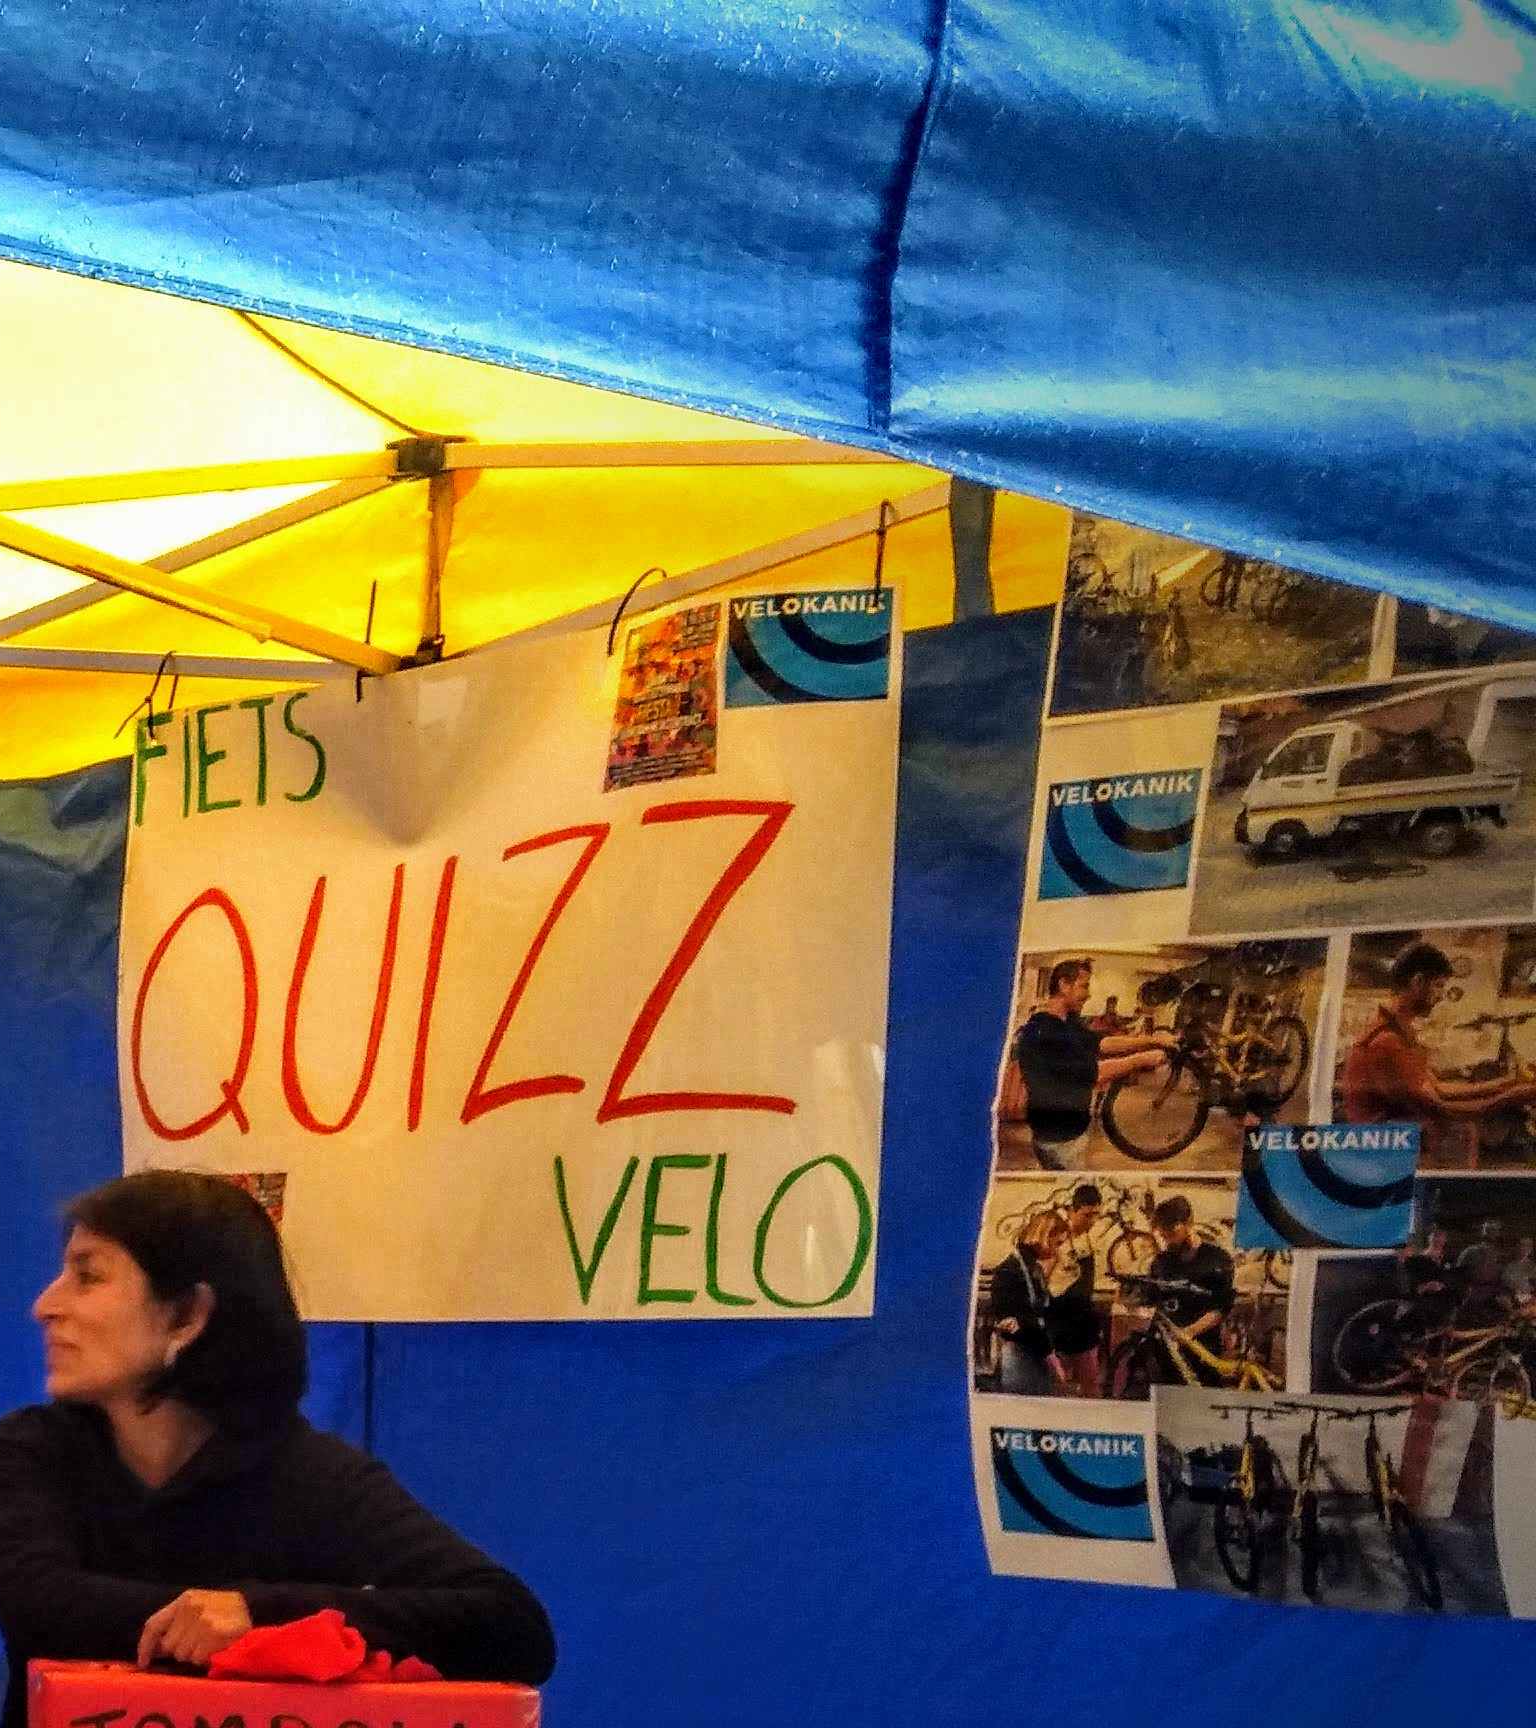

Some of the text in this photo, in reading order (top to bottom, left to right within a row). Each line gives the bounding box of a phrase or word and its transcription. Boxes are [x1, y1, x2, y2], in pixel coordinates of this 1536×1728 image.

[134, 692, 327, 827] FIETS
[1050, 774, 1195, 807] VELOKANIK
[131, 801, 797, 1141] QUIZZ
[1249, 1130, 1412, 1152] VELOKANIK
[554, 1152, 874, 1307] VELO
[994, 1433, 1139, 1458] VELOKANIK
